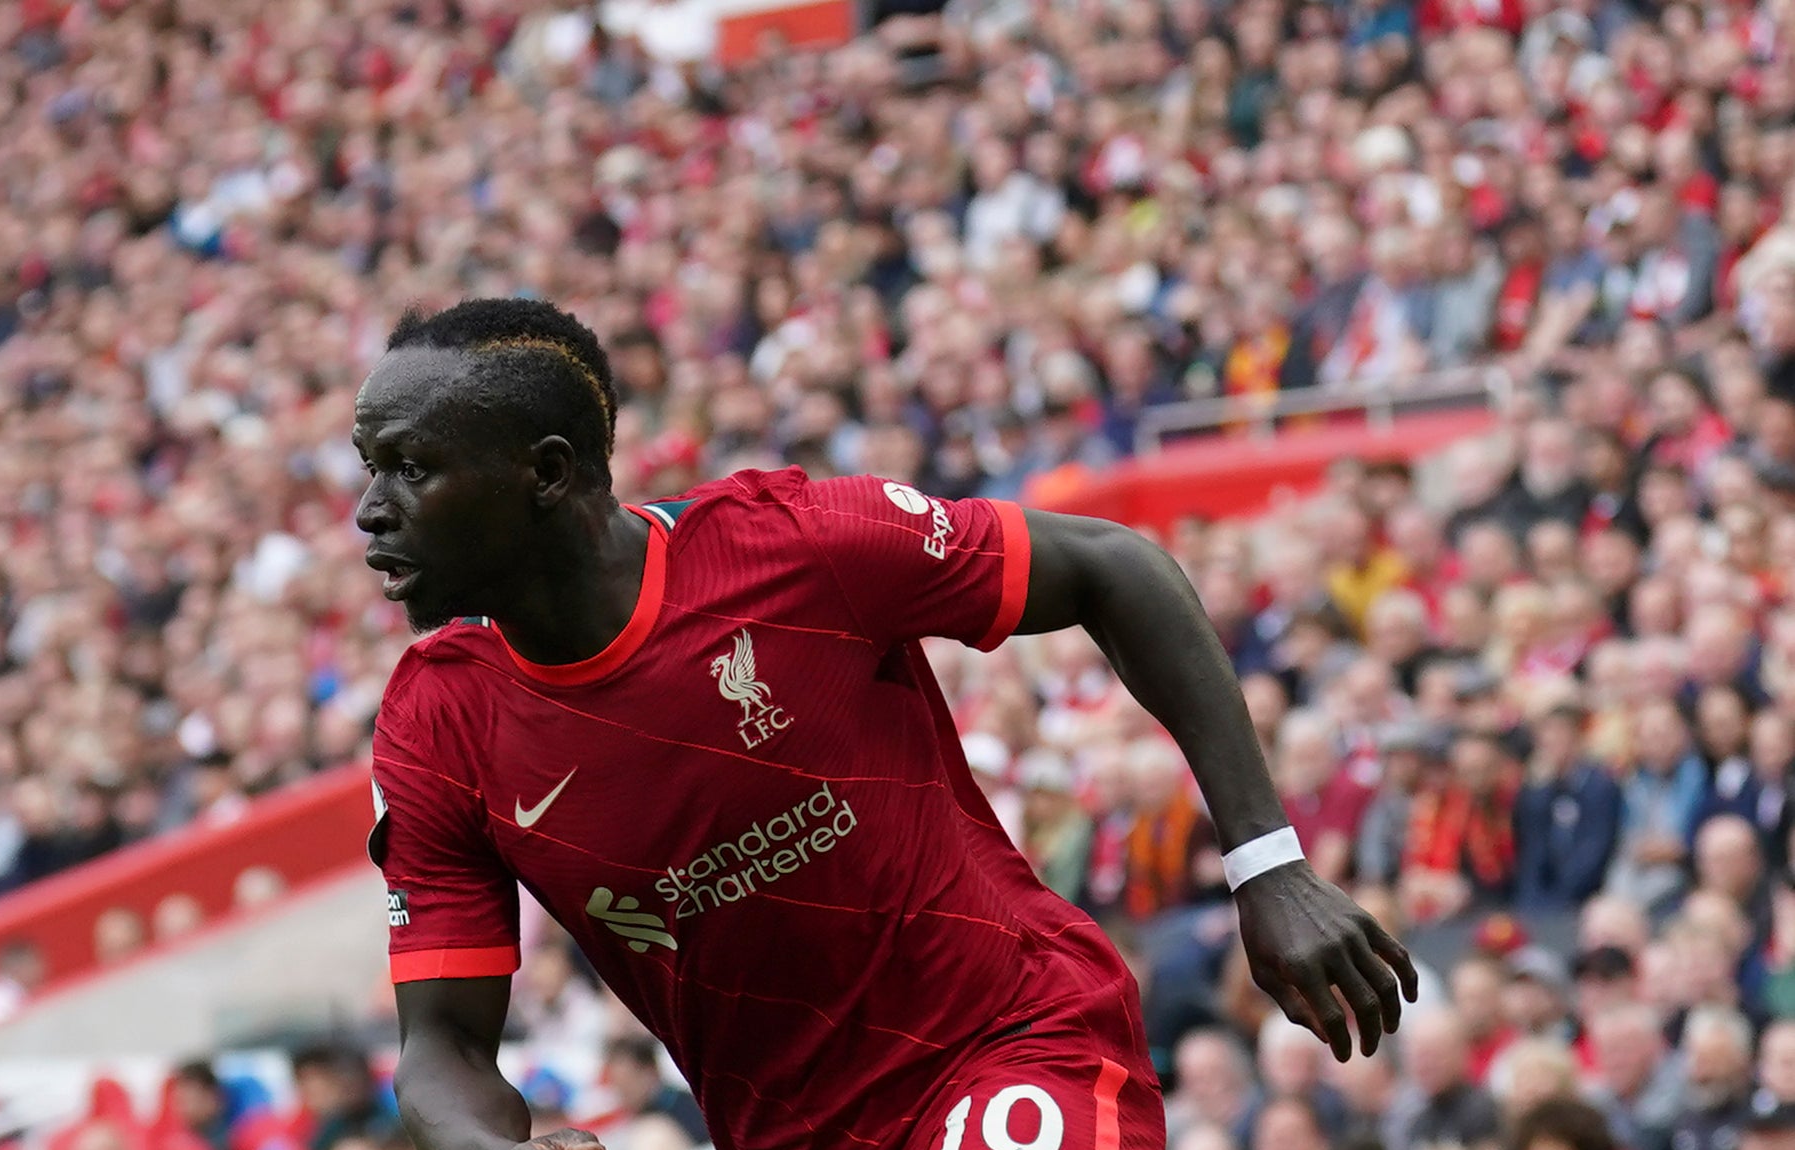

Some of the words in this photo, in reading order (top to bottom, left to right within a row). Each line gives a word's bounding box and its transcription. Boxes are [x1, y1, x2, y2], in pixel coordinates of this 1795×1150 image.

[738, 707, 795, 750] L.F.C.
[654, 780, 836, 902] standard
[675, 799, 858, 919] chartered
